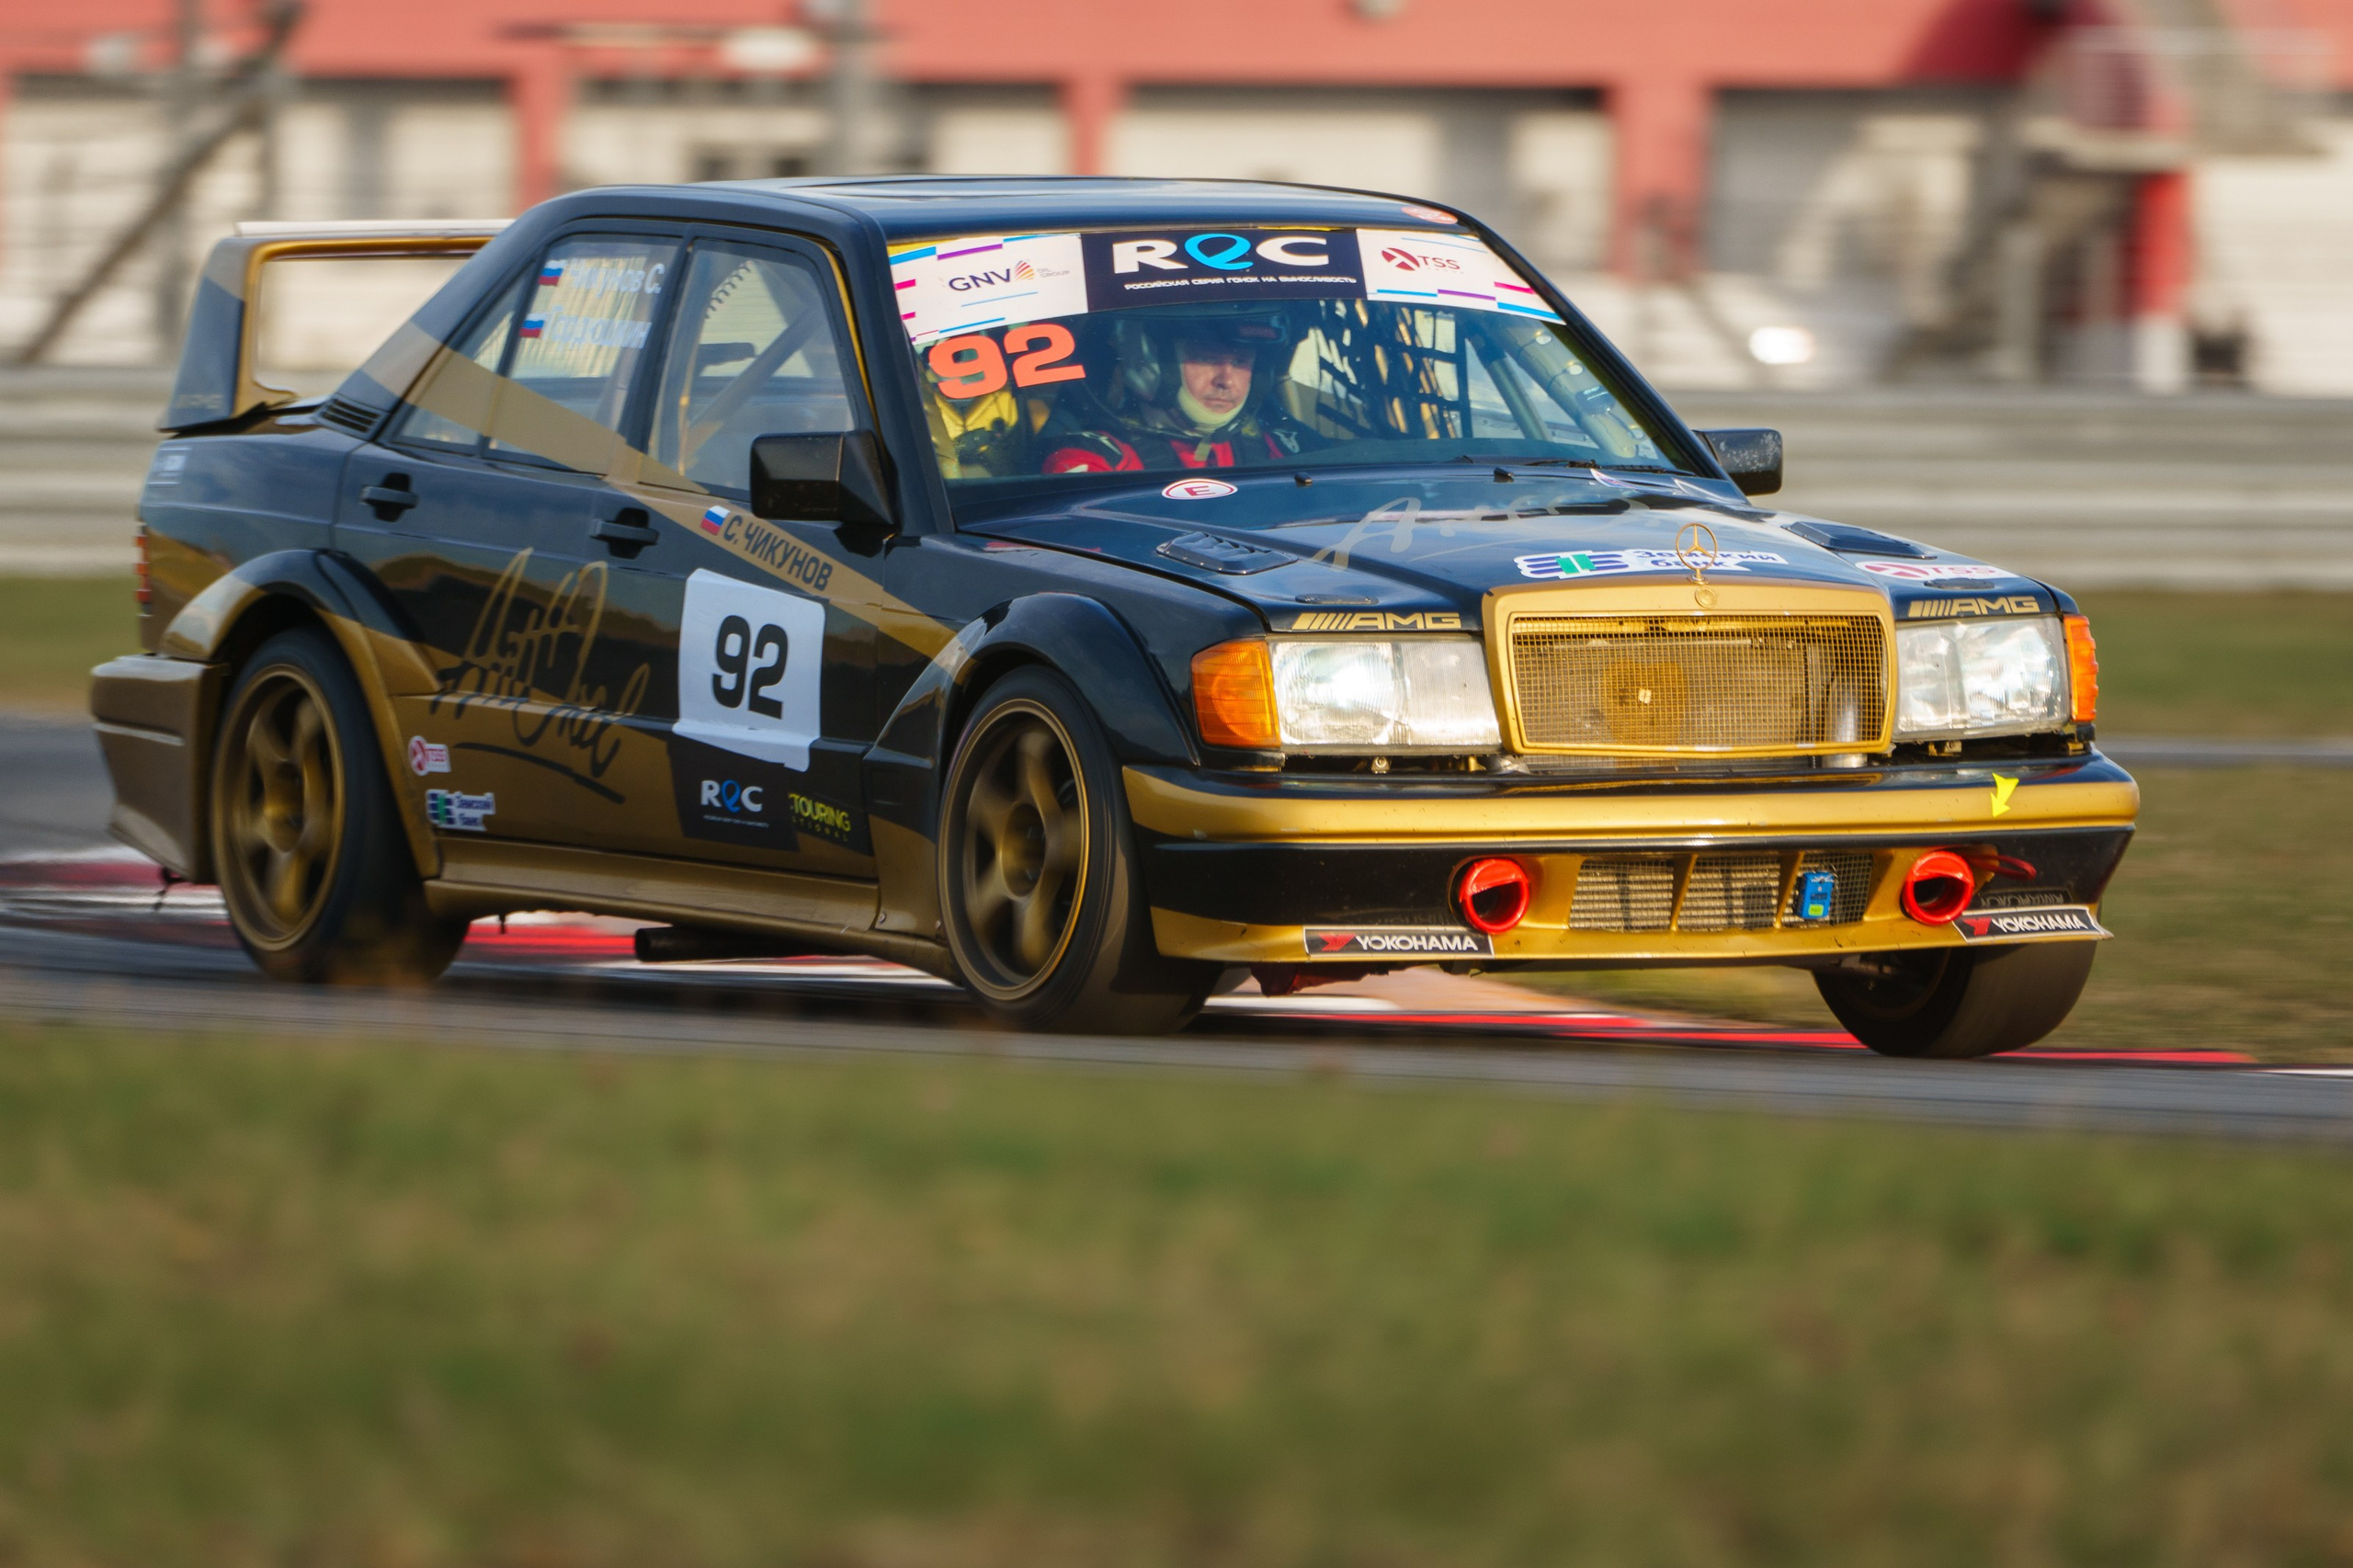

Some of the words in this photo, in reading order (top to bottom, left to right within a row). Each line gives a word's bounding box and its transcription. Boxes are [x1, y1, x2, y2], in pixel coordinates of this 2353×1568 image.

[1417, 255, 1461, 270] TSS
[949, 267, 1011, 292] GNV
[1124, 279, 1188, 290] РОССИЙСКАЯ
[1278, 276, 1357, 284] ВЫНОСЛИВОСТЬ
[928, 323, 1086, 399] 92
[1184, 485, 1216, 496] E
[744, 523, 834, 592] ЧИКУНОВ
[1949, 596, 2040, 617] AMG
[1345, 612, 1461, 630] AMG
[712, 614, 789, 721] 92
[788, 792, 851, 832] TOURING
[1992, 914, 2088, 933] YOKOHAMA
[1355, 934, 1479, 952] YOKOHAMA
